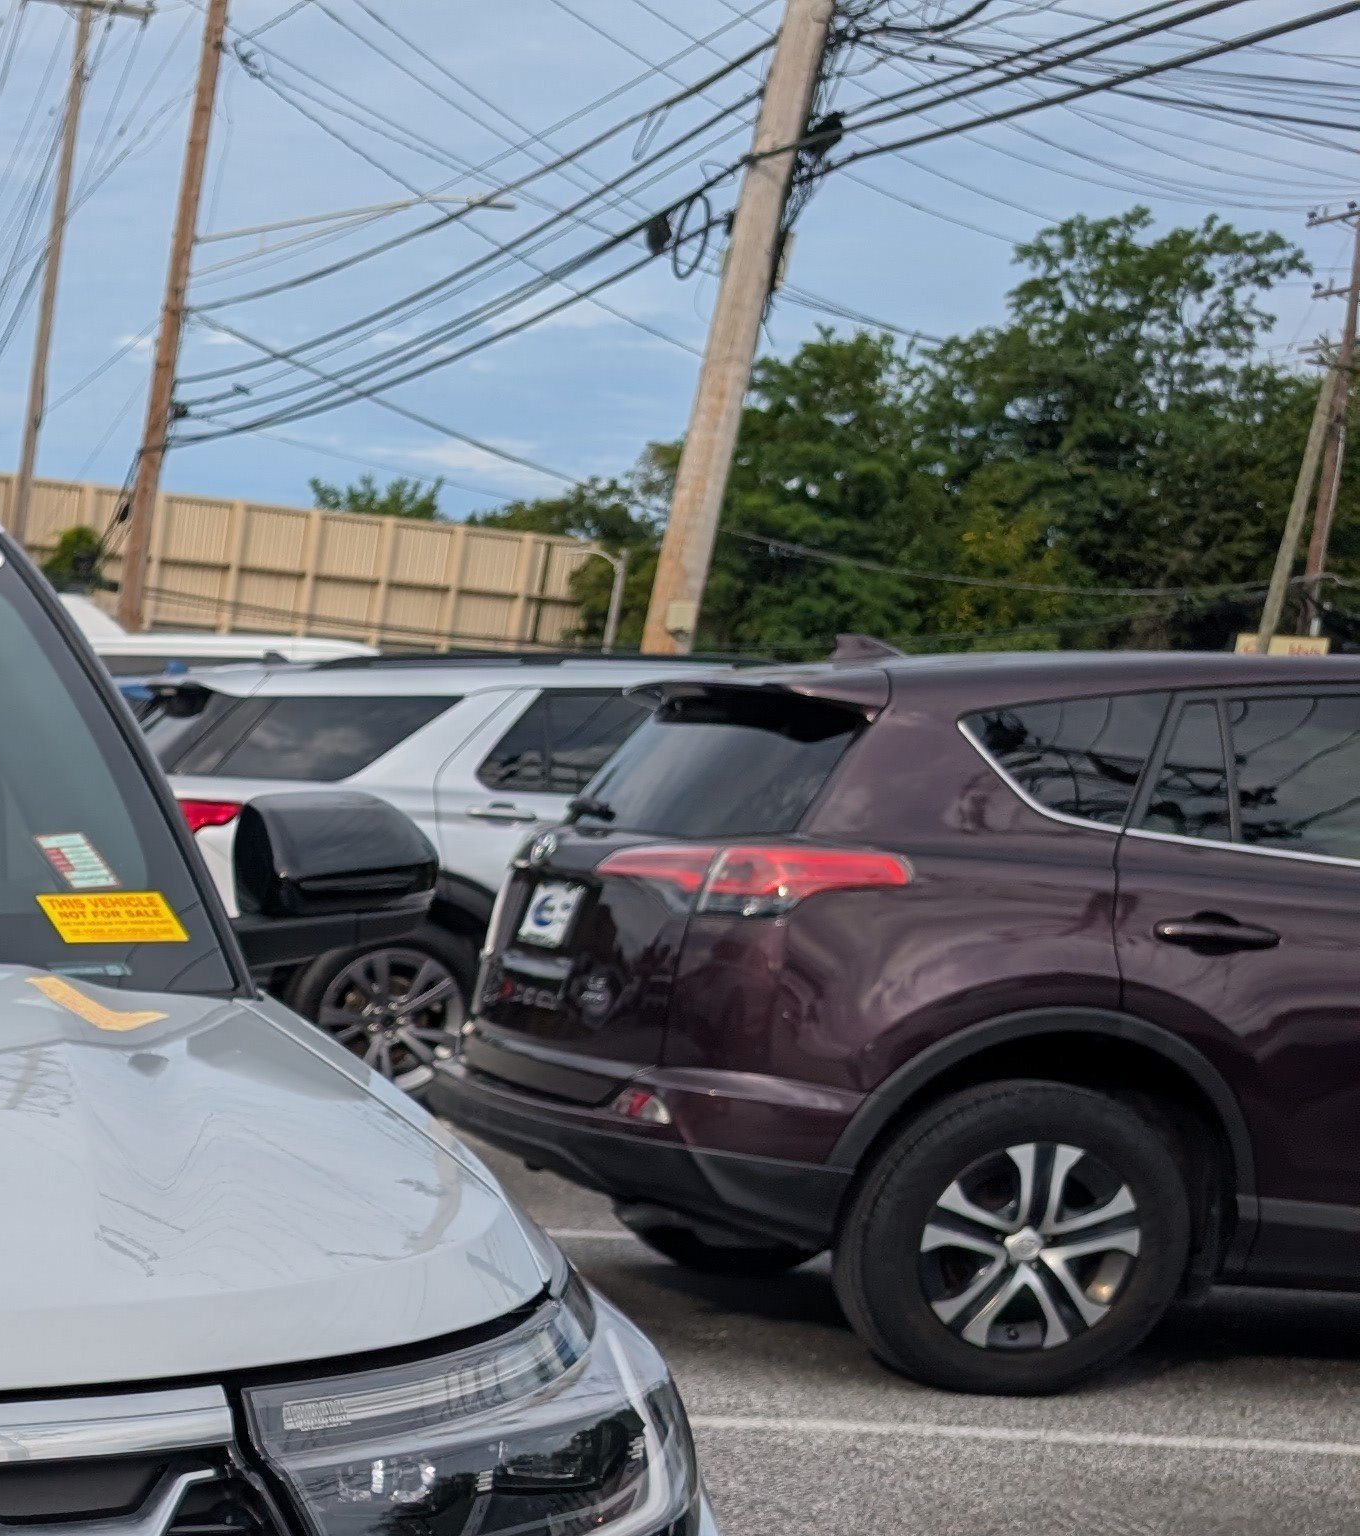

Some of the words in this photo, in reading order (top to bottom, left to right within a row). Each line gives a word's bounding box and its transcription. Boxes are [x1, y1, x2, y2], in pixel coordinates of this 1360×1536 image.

[47, 898, 86, 909] THIS
[87, 896, 160, 908] VEHICLE
[57, 911, 87, 919] NOT
[91, 910, 121, 918] FOR
[125, 909, 163, 918] SALE
